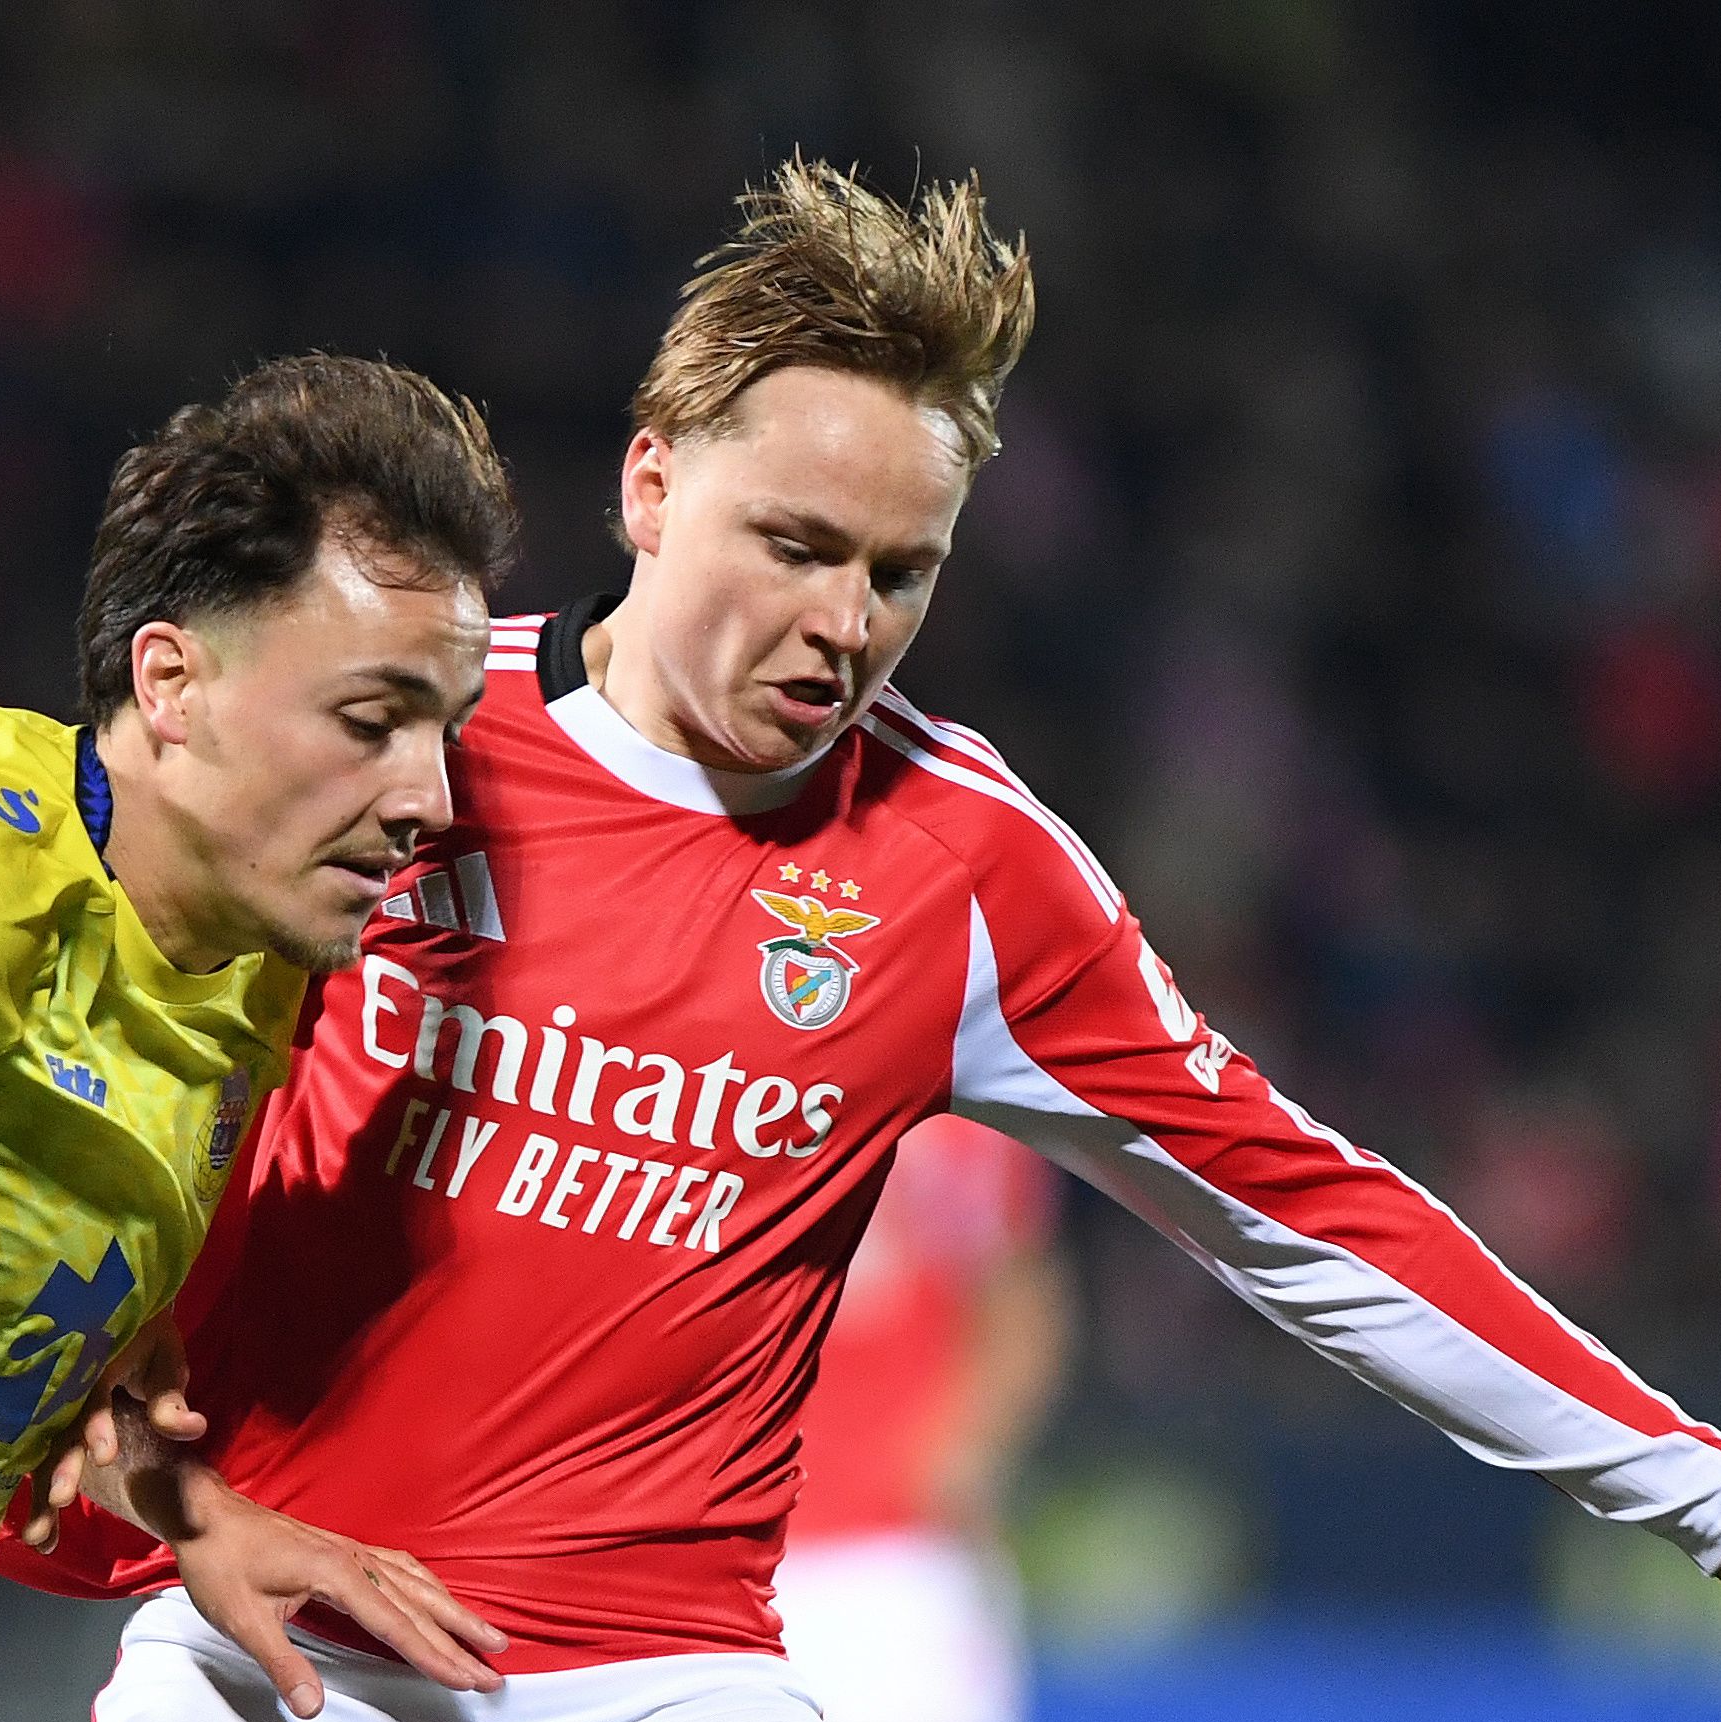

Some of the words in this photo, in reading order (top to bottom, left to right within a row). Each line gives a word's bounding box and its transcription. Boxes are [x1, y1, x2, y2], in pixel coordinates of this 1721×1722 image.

[361, 953, 845, 1159] Emirates
[384, 1098, 501, 1199] FLY
[495, 1132, 745, 1254] BETTER
